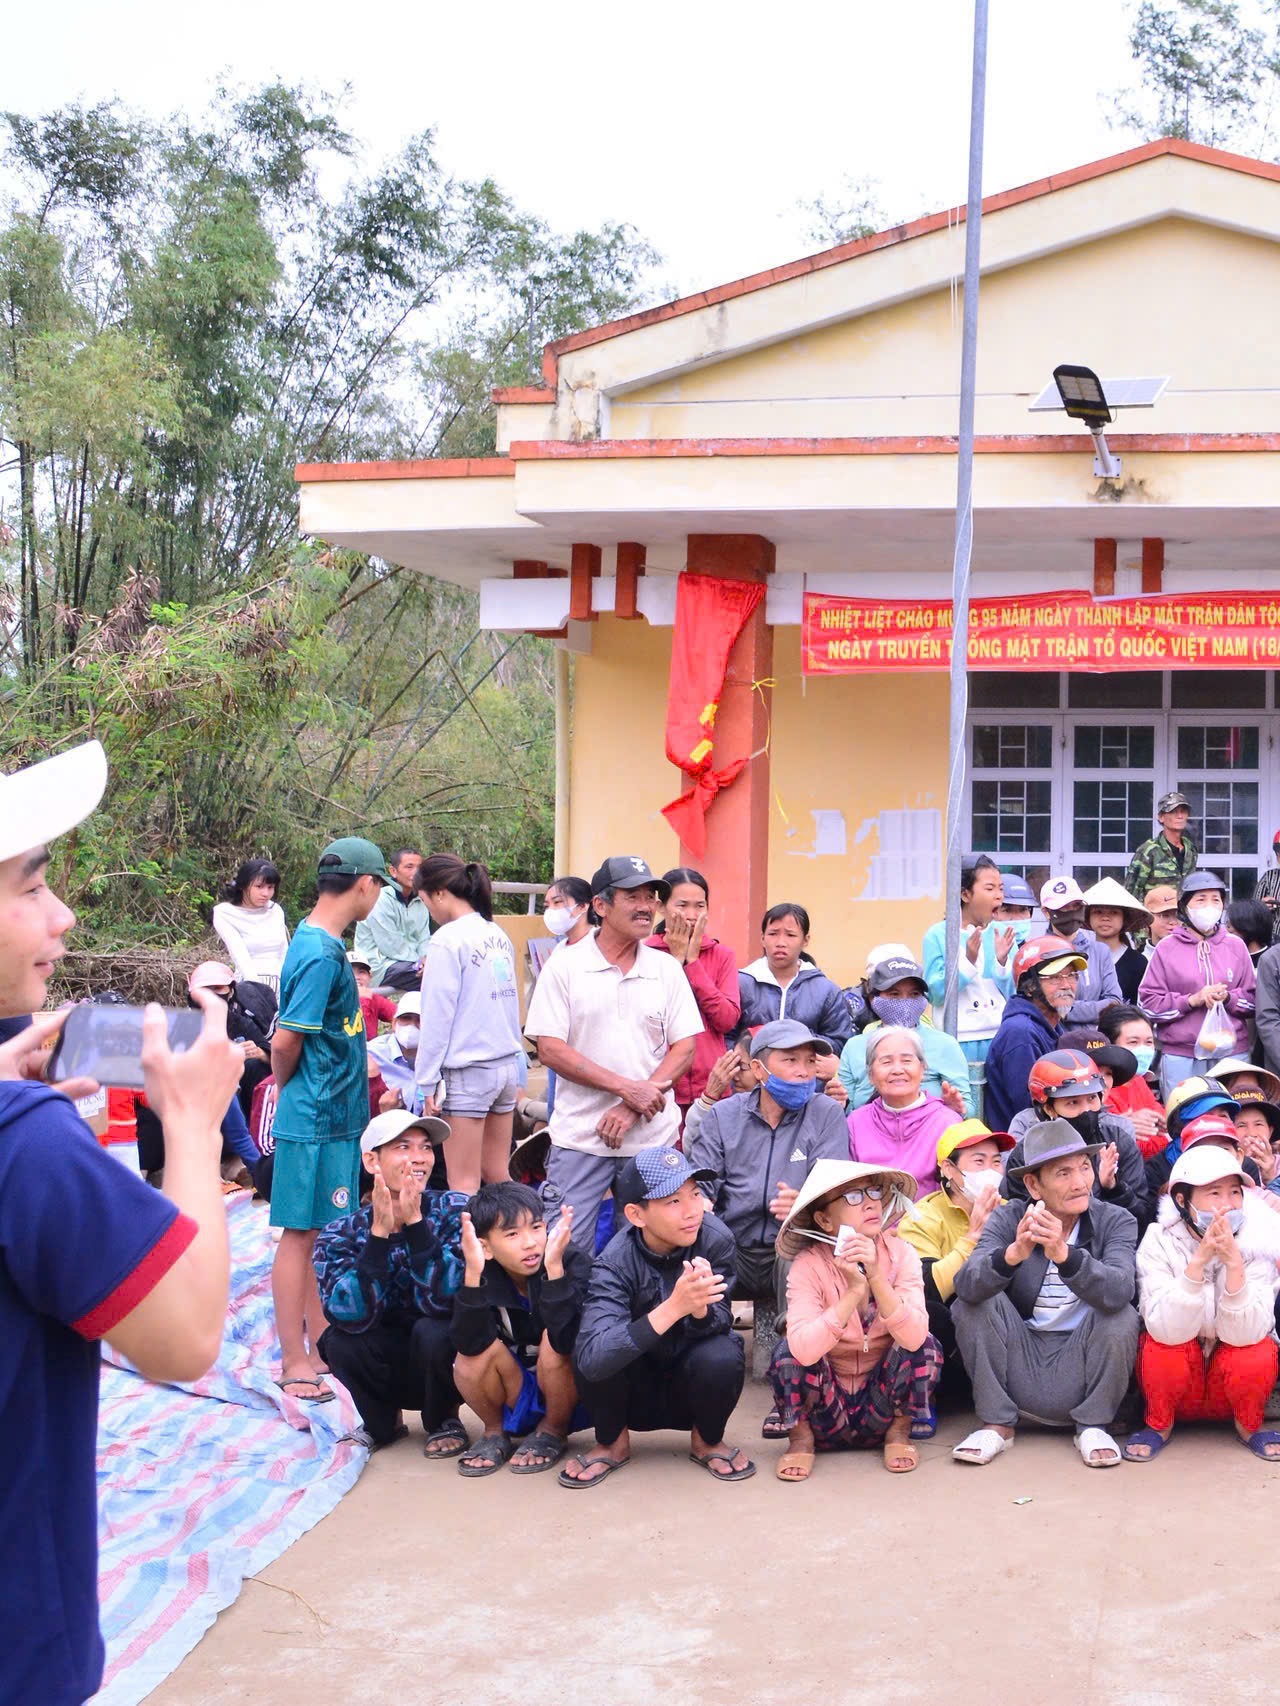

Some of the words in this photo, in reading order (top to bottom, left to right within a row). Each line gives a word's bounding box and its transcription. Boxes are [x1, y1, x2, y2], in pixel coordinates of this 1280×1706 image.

[821, 606, 861, 634] NHIỆT
[864, 606, 892, 634] LIỆT
[896, 606, 934, 629] CHÀO
[937, 608, 979, 628] MG
[981, 608, 998, 626] 95
[1001, 604, 1030, 627] NĂM
[1035, 603, 1072, 626] NGÀY
[1076, 604, 1121, 626] THÀNH
[1126, 602, 1151, 631] LẬP
[1155, 602, 1186, 630] MẶT
[1187, 603, 1224, 630] TRẬN
[828, 636, 872, 659] NGÀY
[879, 632, 941, 658] TRUYỀN
[946, 631, 1001, 658] TỐNG
[1007, 635, 1040, 662] MẶT
[1046, 634, 1089, 662] TRẬN
[1094, 627, 1116, 657] TỔ
[1119, 630, 1167, 657] QUỐC
[1171, 632, 1207, 662] VIỆT
[1212, 637, 1248, 657] NAM
